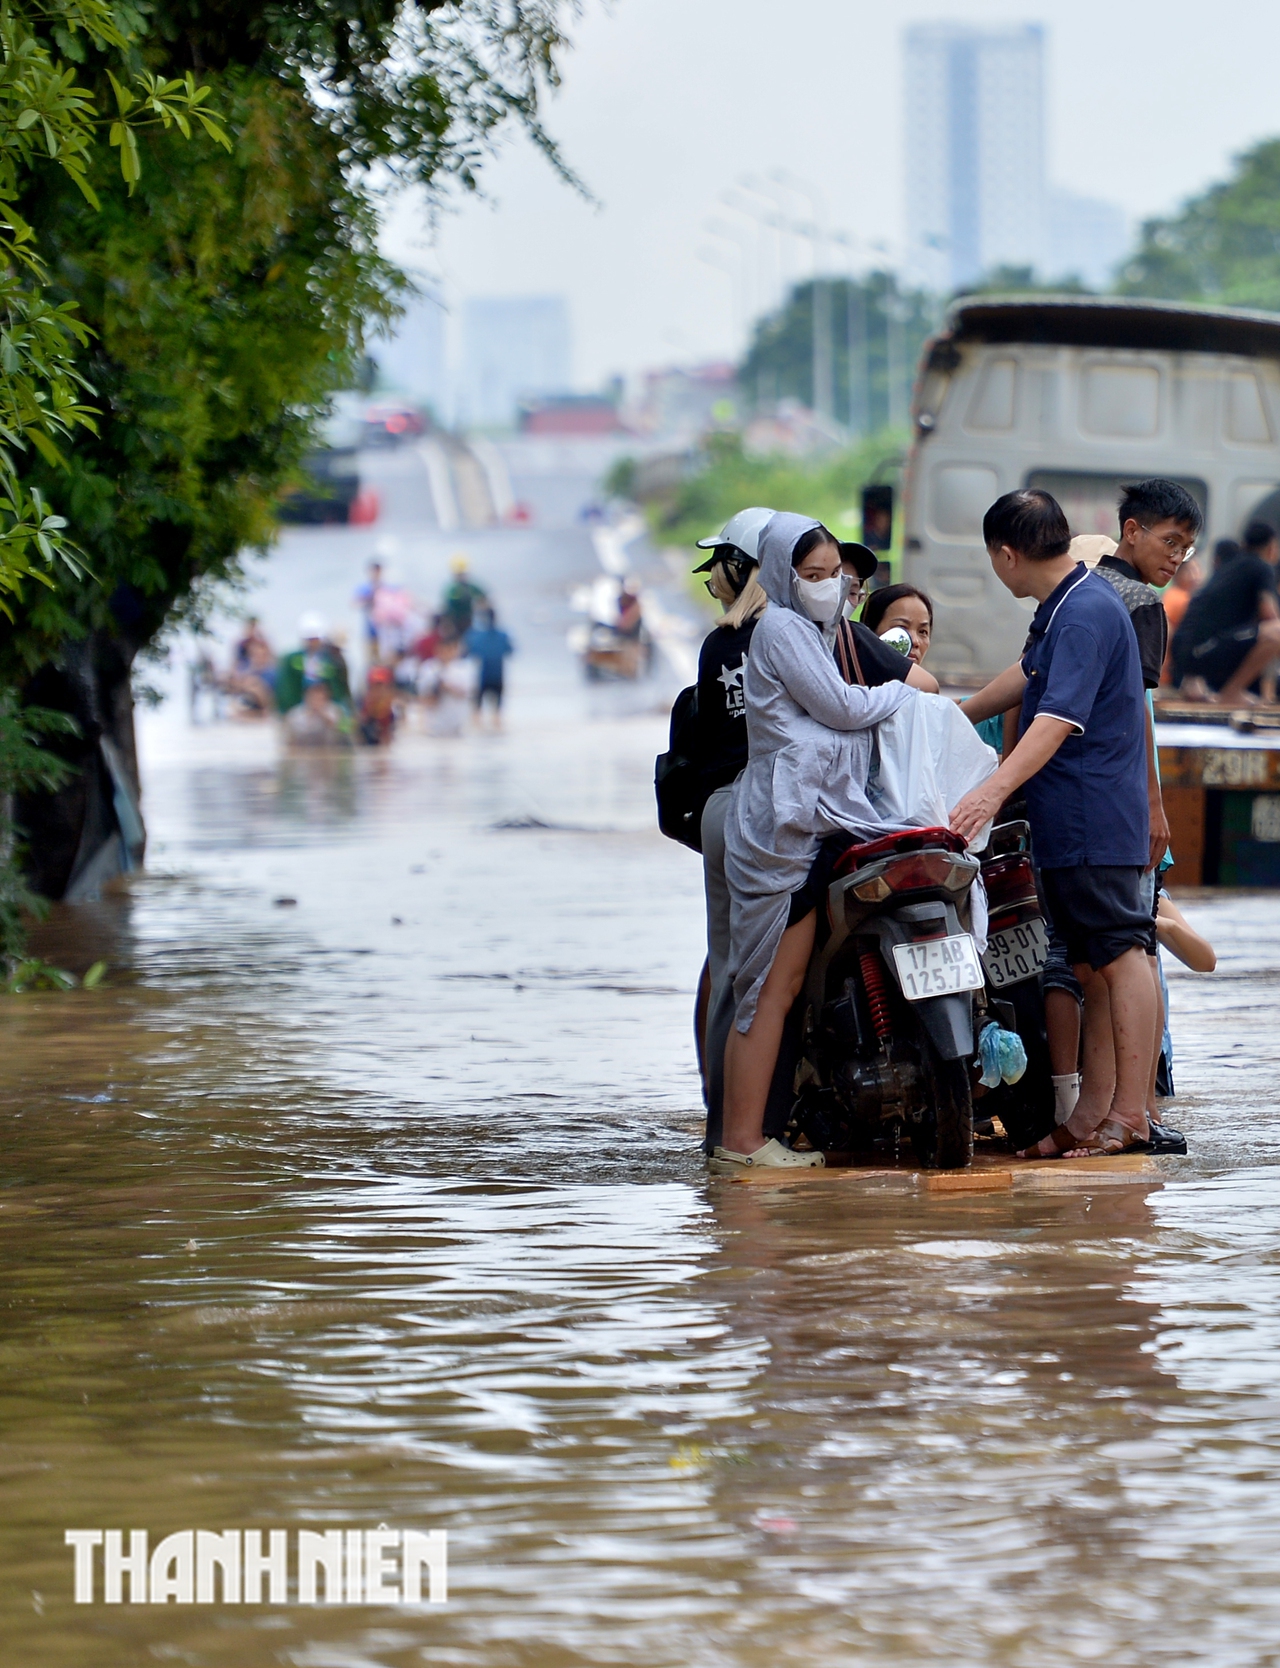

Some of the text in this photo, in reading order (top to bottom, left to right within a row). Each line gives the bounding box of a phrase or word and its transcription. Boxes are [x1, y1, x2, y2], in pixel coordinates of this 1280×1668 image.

[907, 940, 965, 970] 17-AB
[988, 923, 1040, 959] 99-D1
[906, 963, 979, 996] 125.73
